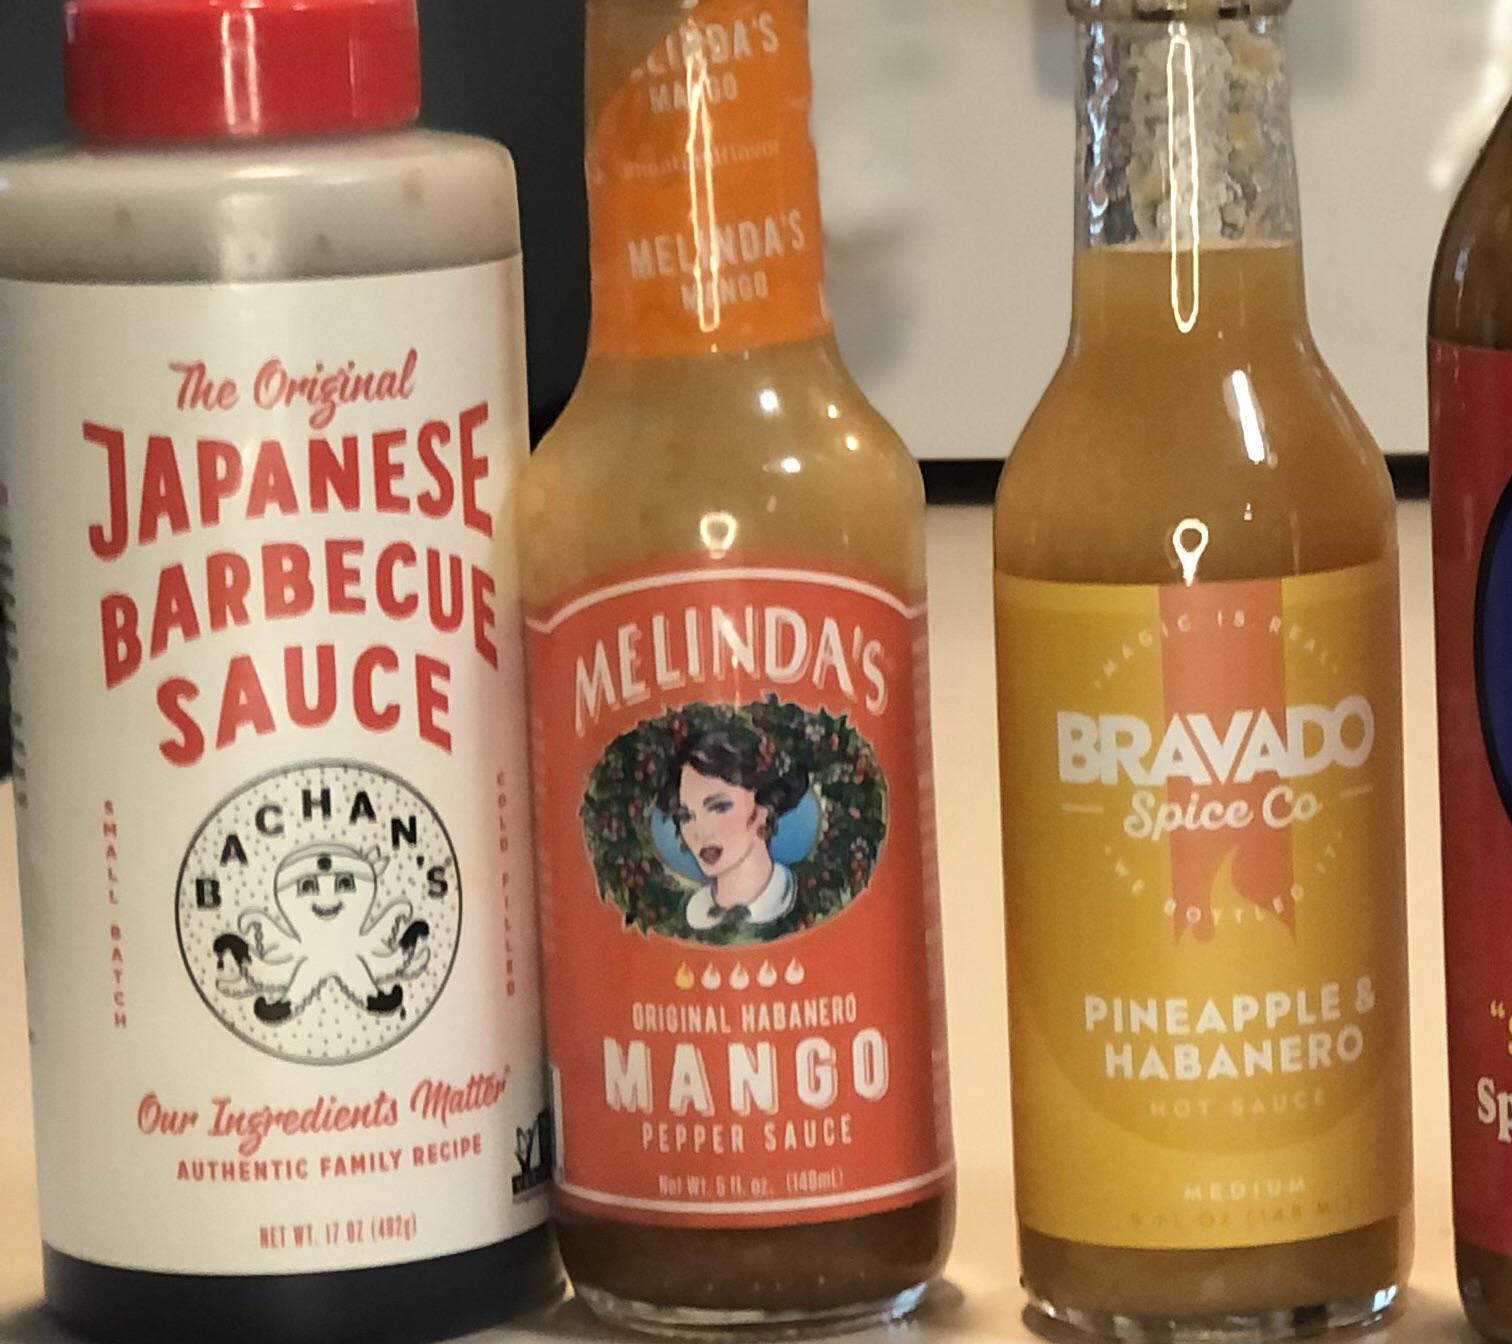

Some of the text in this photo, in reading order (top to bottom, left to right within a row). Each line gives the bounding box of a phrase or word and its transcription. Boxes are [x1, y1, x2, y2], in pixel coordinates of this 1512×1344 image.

[627, 210, 806, 280] MELINDA'S
[169, 348, 418, 430] The Original
[82, 401, 493, 561] JAPANESE
[100, 539, 498, 690] BARBECUE
[156, 643, 452, 767] SAUCE
[574, 604, 888, 739] MELINDA'S
[1056, 694, 1376, 787] BRAVADO
[195, 787, 450, 911] BACHAN'S
[1123, 784, 1255, 843] Spice
[102, 799, 127, 1029] SMALL BATCH
[631, 992, 857, 1035] ORIGINAL HABANERO
[1083, 974, 1376, 1037] PINEAPPLE &
[603, 1027, 889, 1117] MANGO
[1104, 1024, 1365, 1082] HABANERO
[137, 1072, 508, 1157] Our Ingredients Matter
[642, 1113, 853, 1156] PEPPER SAUCE
[1149, 1088, 1328, 1120] HOT SAUCE
[176, 1133, 483, 1182] AUTHENTIC FAMILY RECIPE
[1182, 1175, 1307, 1203] MEDIUM
[259, 1224, 290, 1250] NET
[325, 1222, 341, 1246] 17
[346, 1220, 365, 1245] OZ
